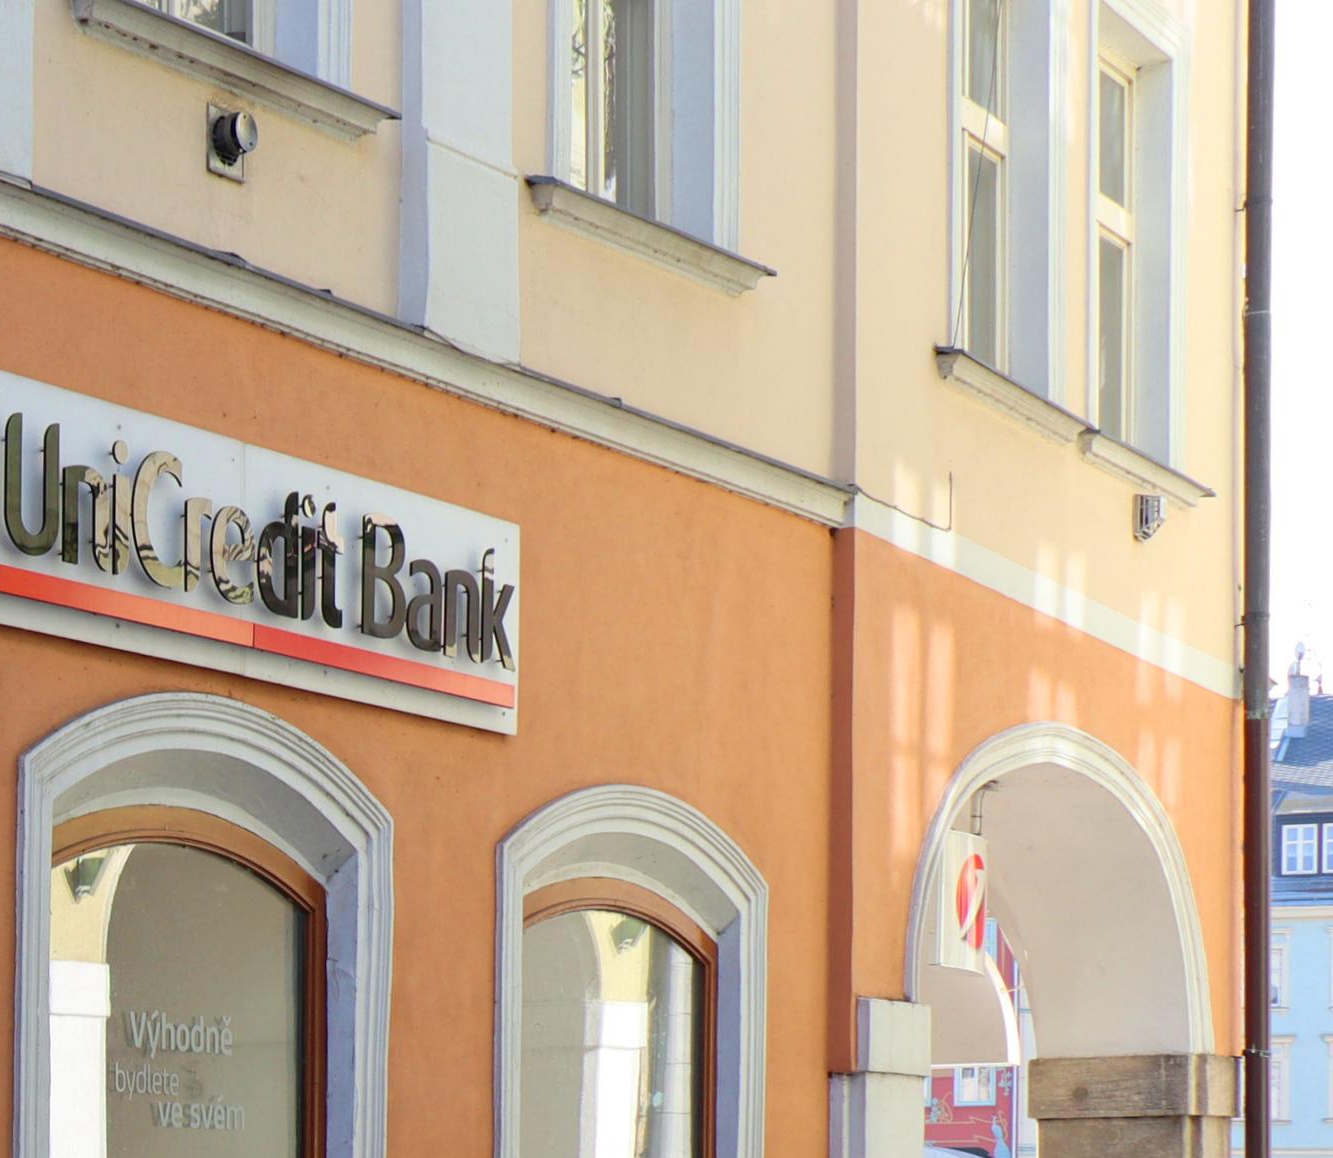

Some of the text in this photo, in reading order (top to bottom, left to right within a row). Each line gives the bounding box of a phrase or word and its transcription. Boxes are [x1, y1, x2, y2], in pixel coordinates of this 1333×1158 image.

[3, 411, 515, 672] UniCredit Bank
[129, 1010, 233, 1059] Výhodně
[114, 1062, 180, 1101] bydlete
[157, 1094, 246, 1131] ve svém
